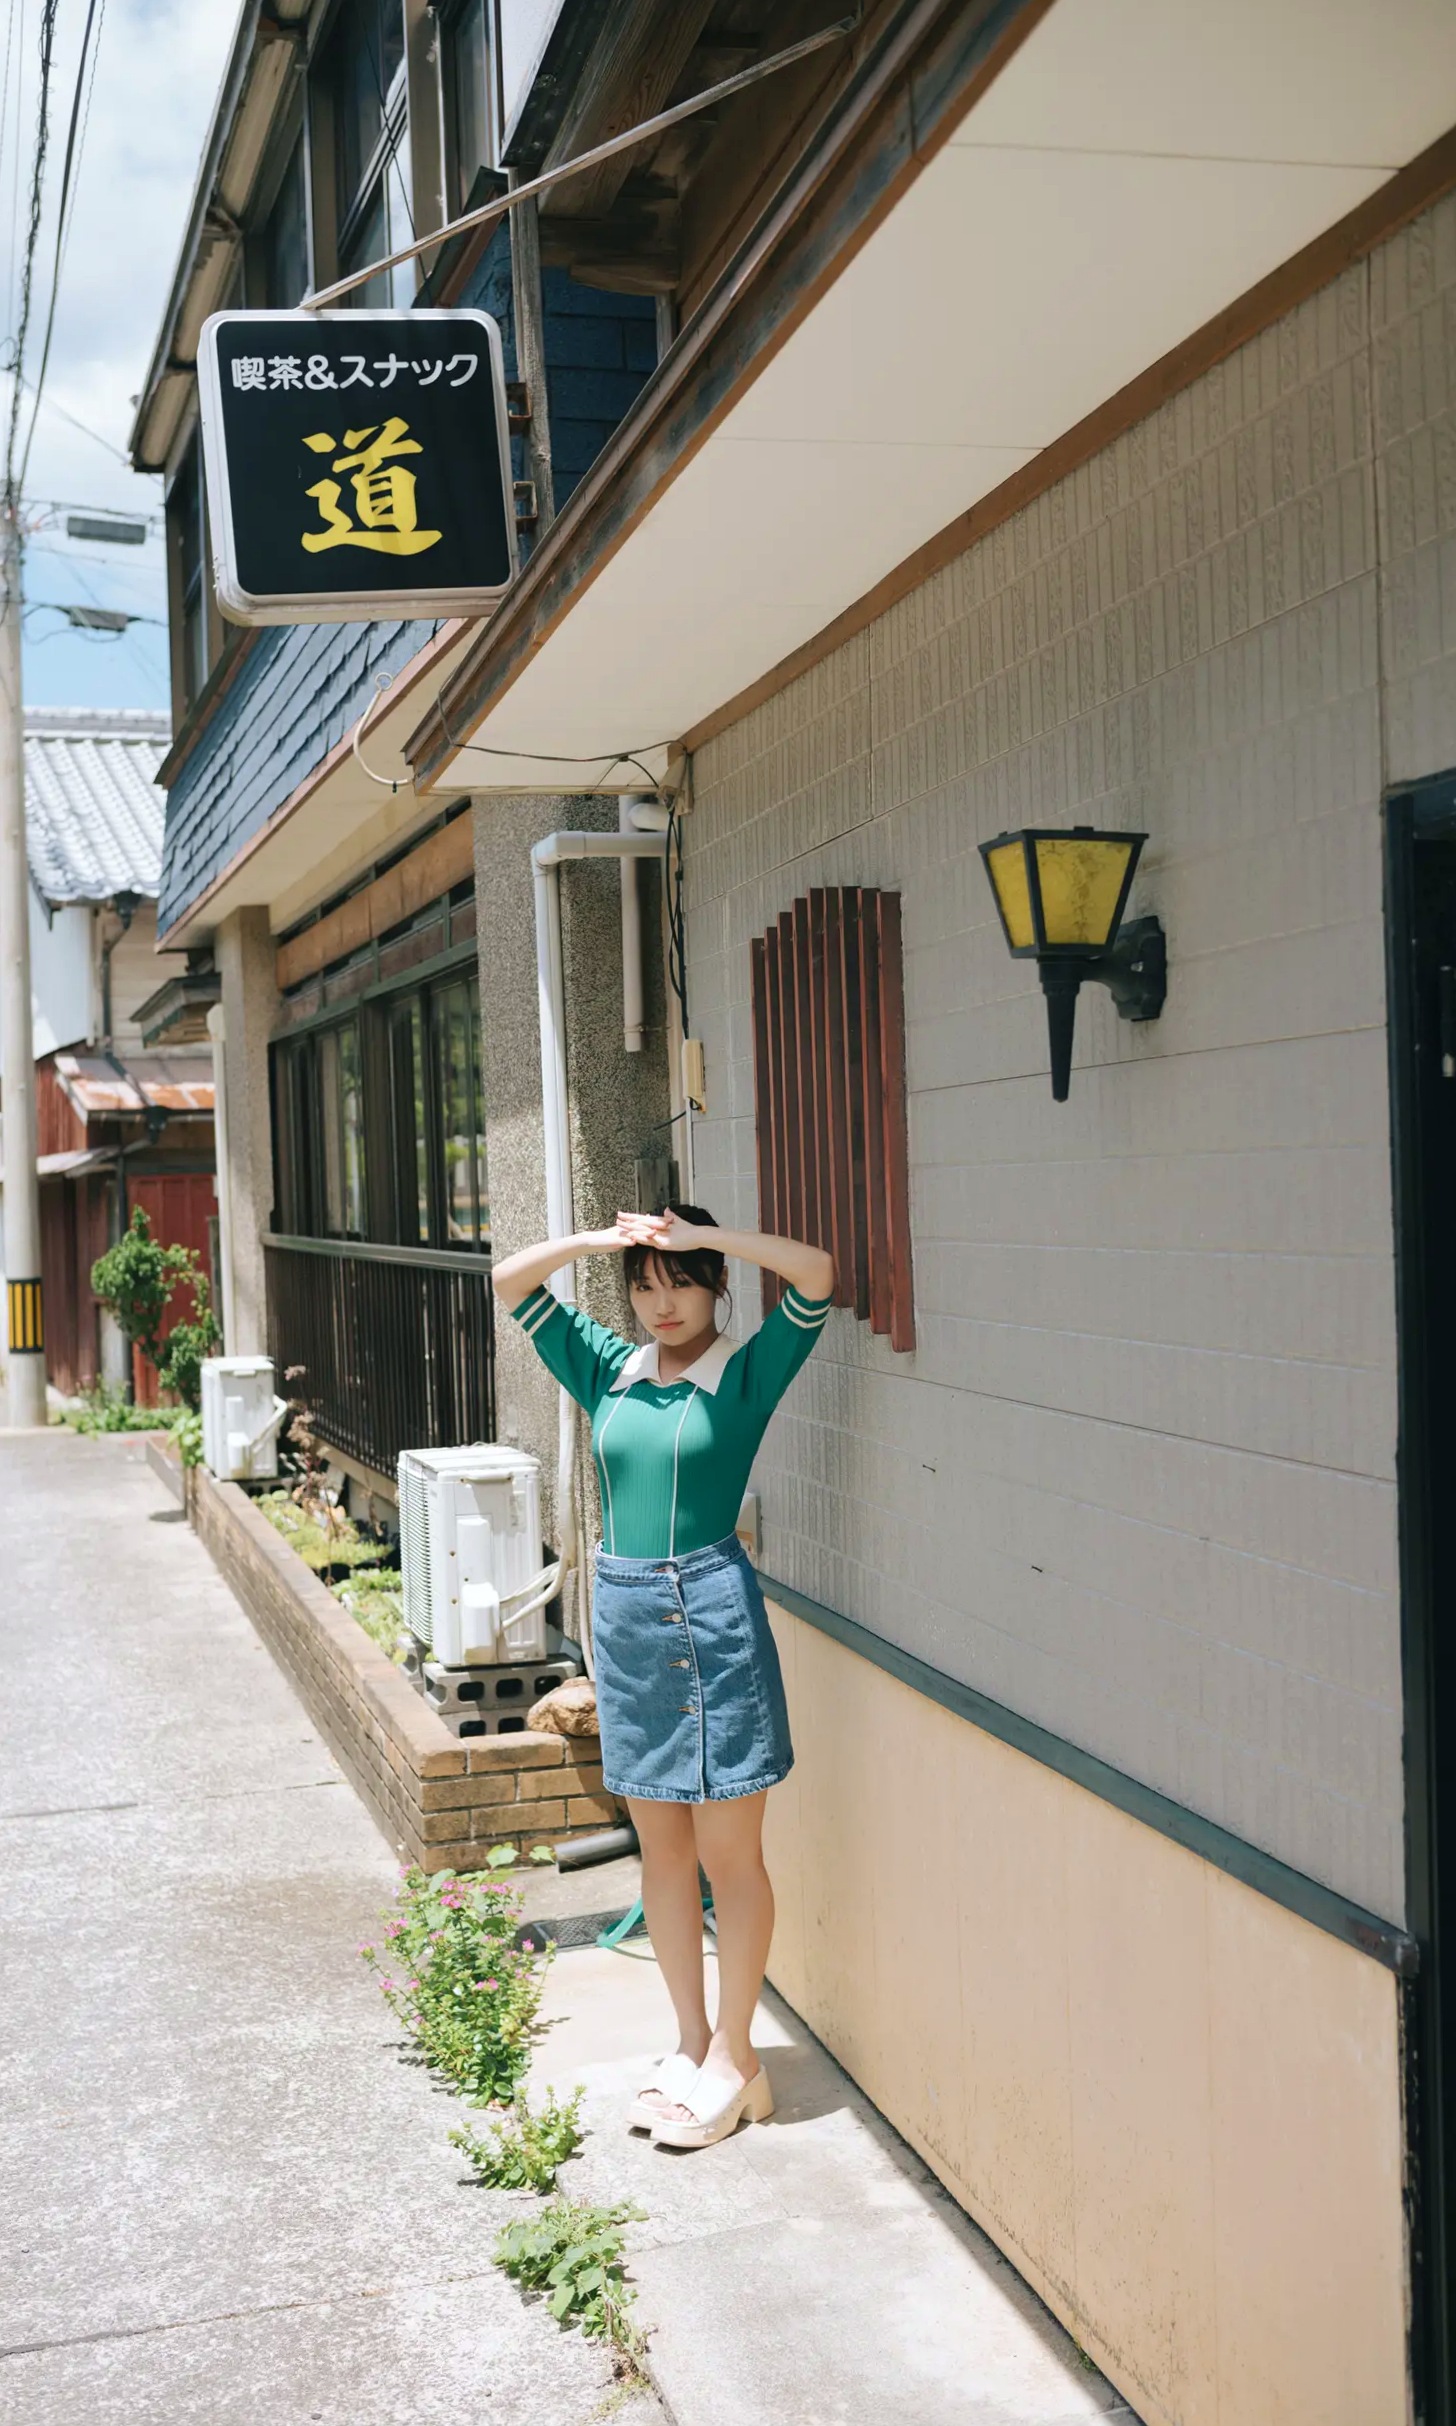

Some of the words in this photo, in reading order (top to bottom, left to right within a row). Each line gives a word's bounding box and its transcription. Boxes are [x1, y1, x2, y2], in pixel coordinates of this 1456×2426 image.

[231, 353, 478, 391] 喫茶&スナック
[301, 416, 443, 555] 道
